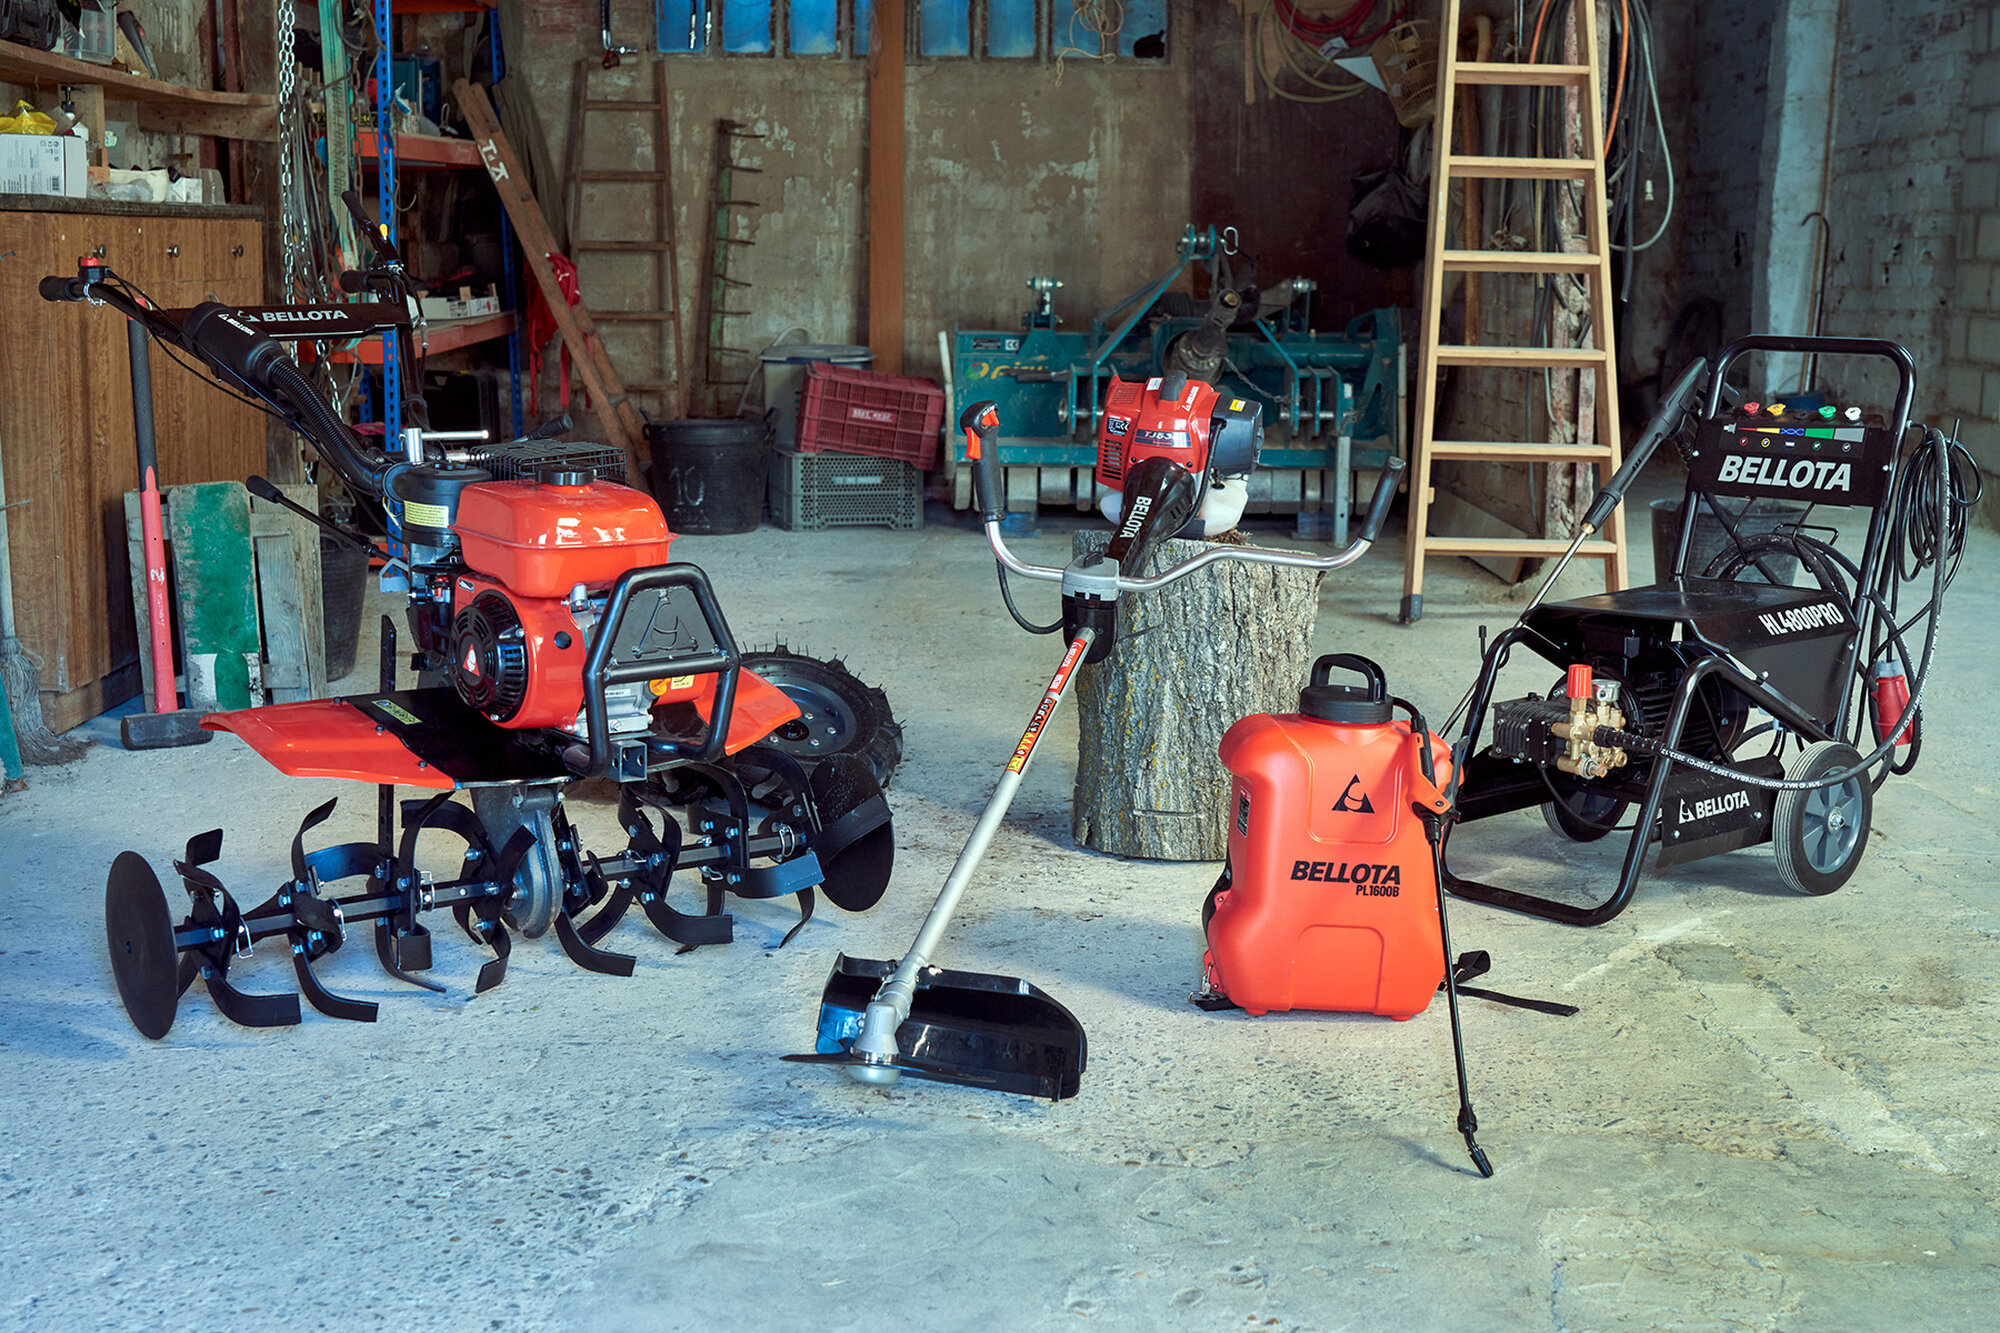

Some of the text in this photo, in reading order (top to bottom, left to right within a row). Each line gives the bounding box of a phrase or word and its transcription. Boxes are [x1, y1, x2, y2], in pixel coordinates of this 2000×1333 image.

[261, 310, 349, 322] BELLOTA
[1717, 455, 1851, 492] BELLOTA
[1119, 496, 1153, 539] BELLOTA
[1758, 601, 1845, 636] HL4800PRO
[1695, 790, 1750, 819] BELLOTA
[1290, 861, 1400, 885] BELLOTA
[1356, 884, 1399, 897] PL1600B
